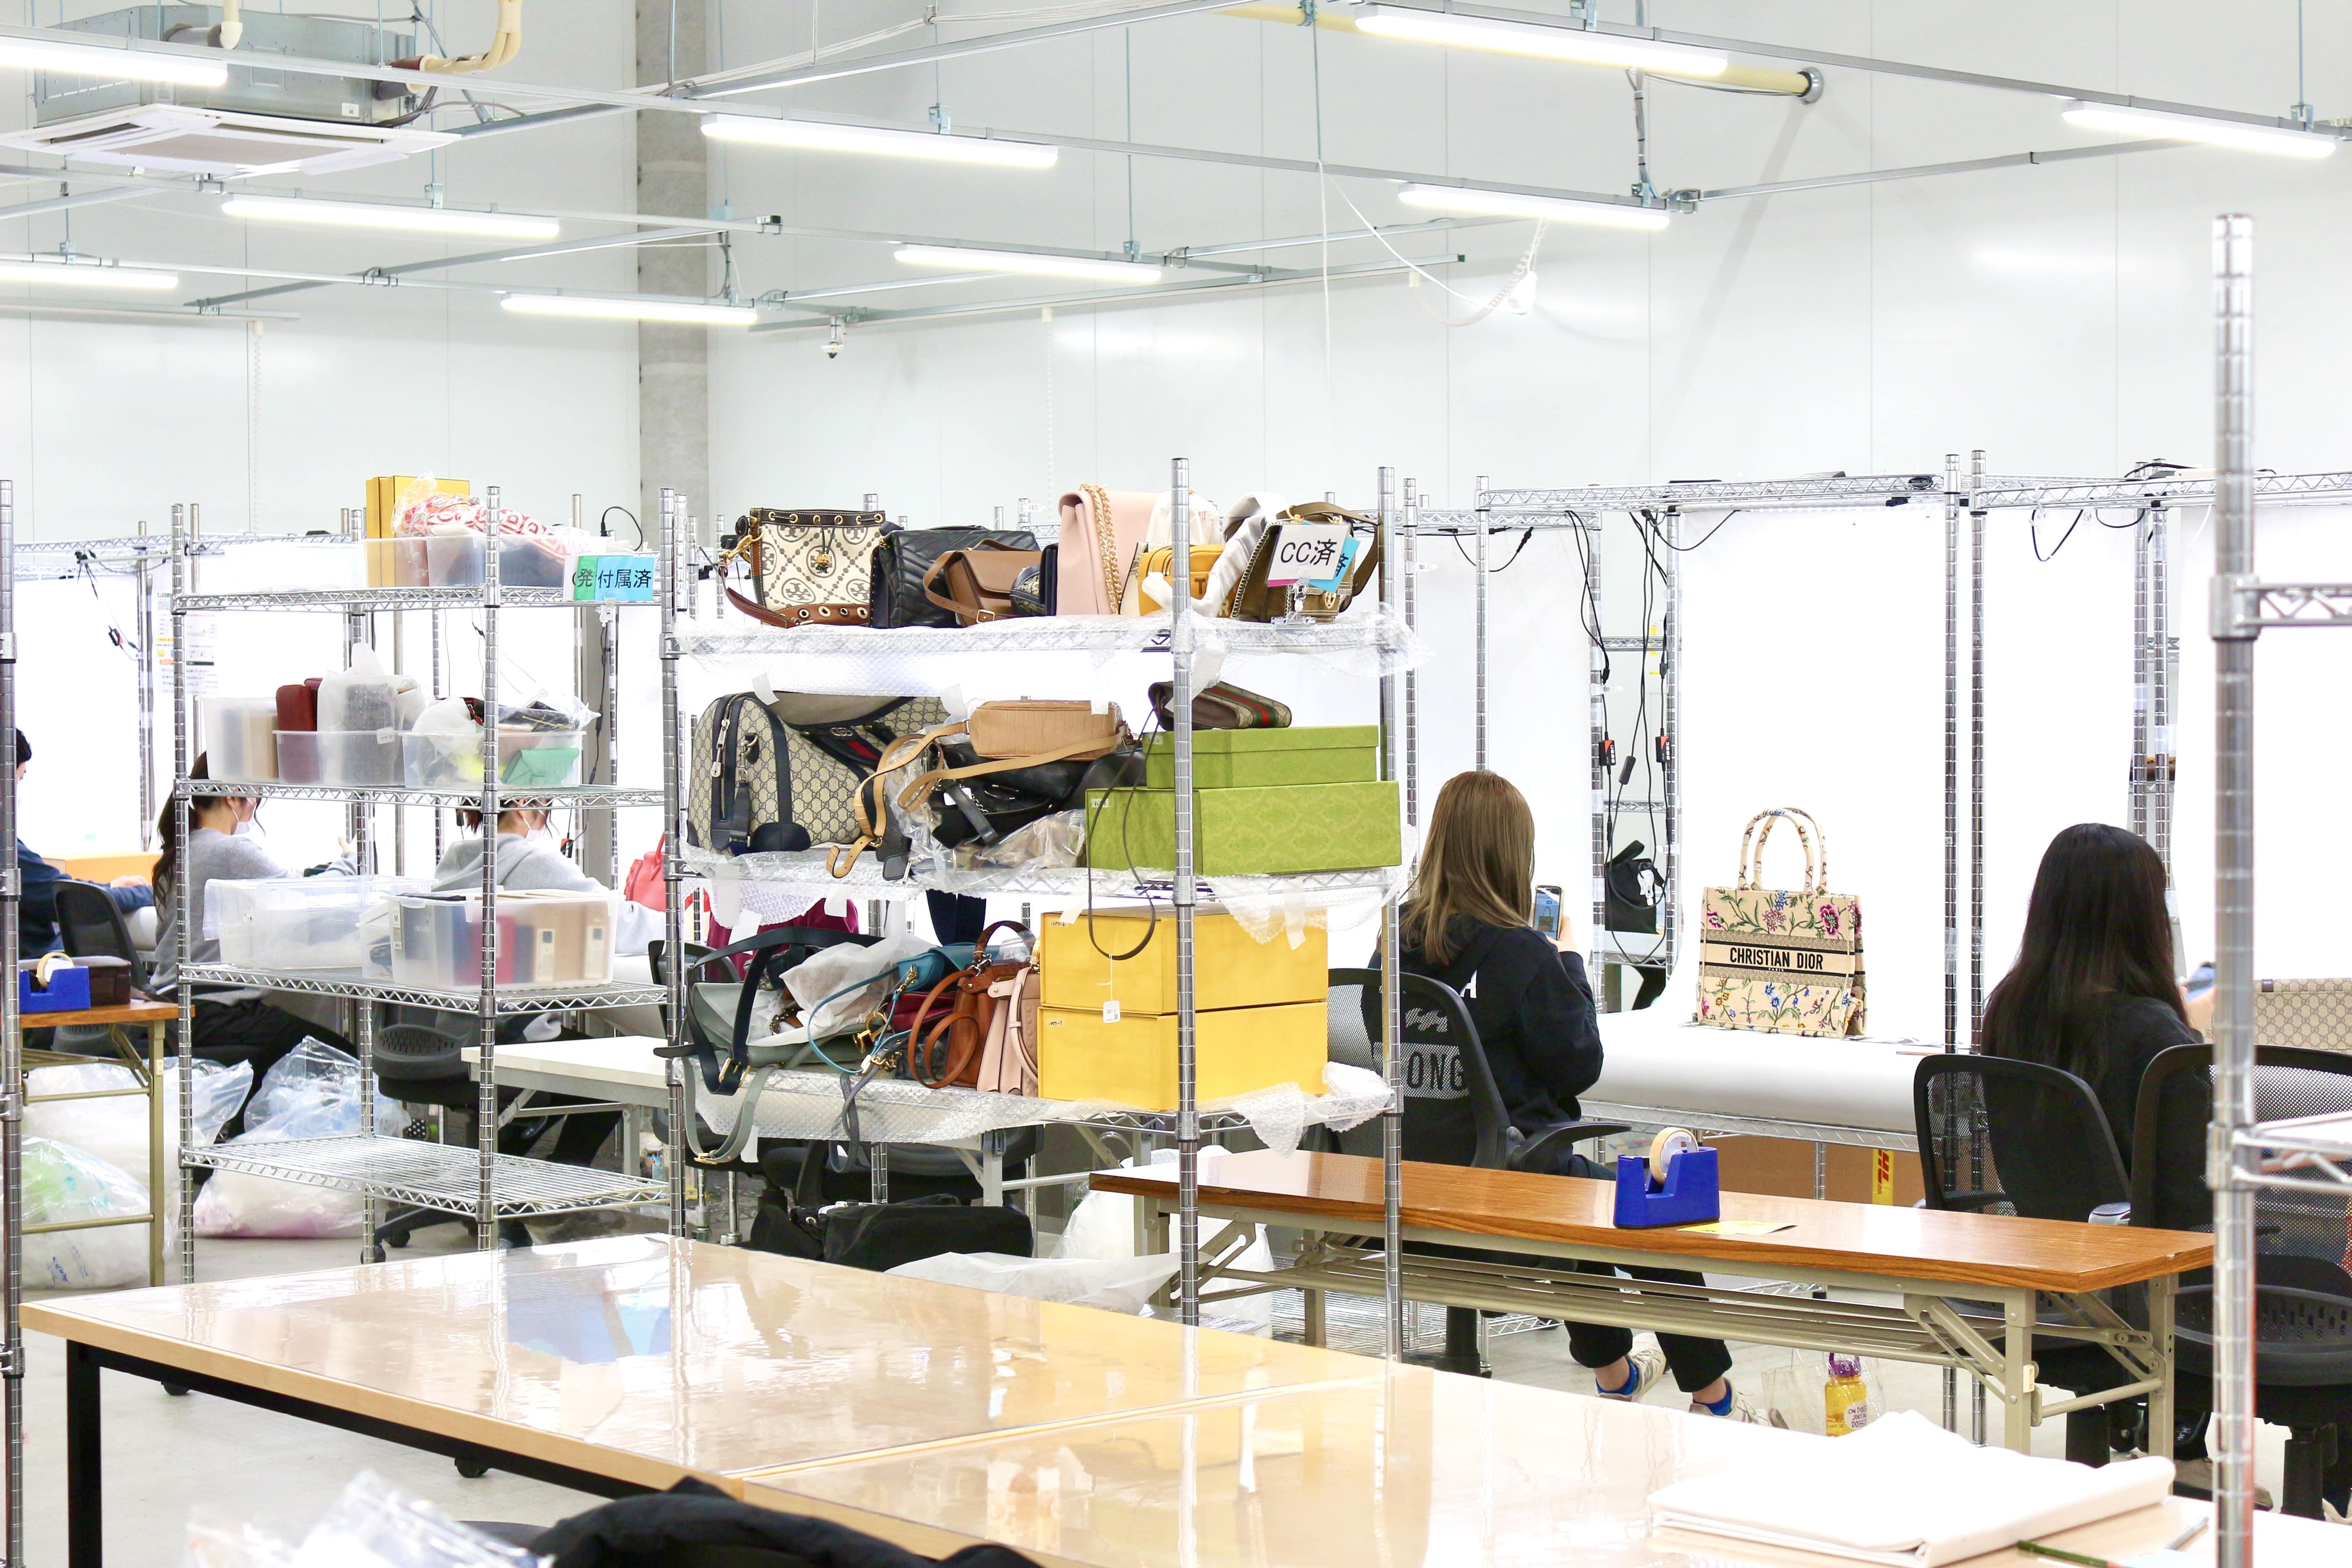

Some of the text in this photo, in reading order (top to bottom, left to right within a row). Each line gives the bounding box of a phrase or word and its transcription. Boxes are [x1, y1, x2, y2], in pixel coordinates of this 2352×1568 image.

[1280, 539, 1337, 565] CC済
[1730, 947, 1823, 970] CHRISTIAN DIOR
